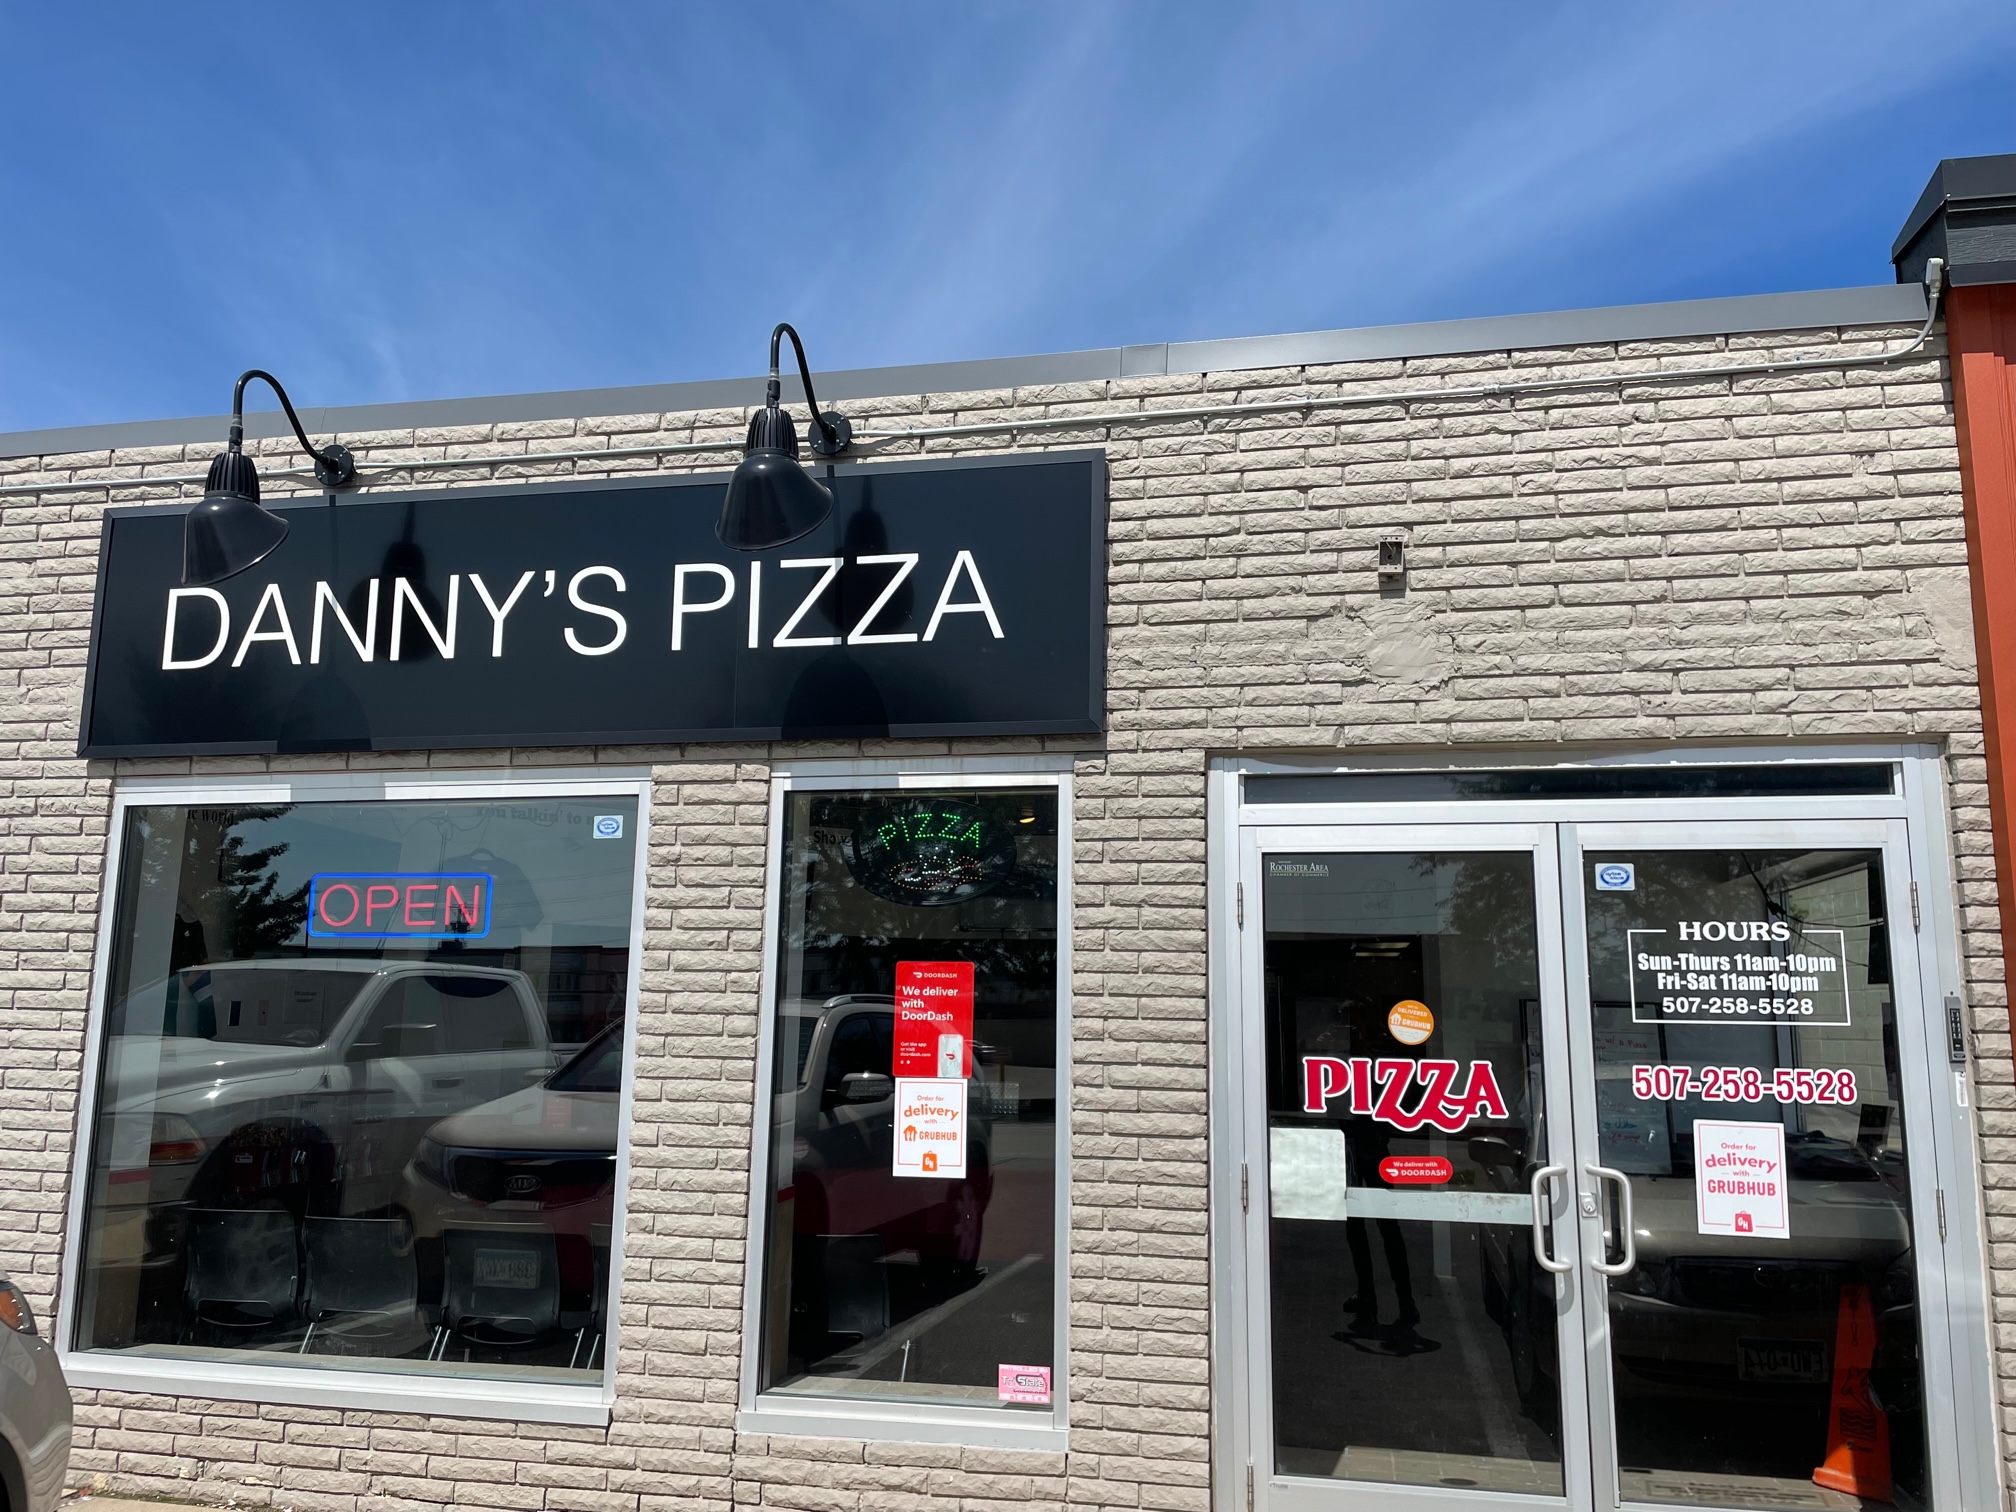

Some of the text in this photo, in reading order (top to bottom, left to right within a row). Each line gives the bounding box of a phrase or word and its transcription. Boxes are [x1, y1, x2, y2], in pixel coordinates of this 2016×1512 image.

[162, 549, 1005, 671] DANNY'S PIZZA
[878, 813, 981, 851] PIZZA
[319, 883, 480, 927] OPEN
[1678, 921, 1791, 942] HOURS
[1637, 952, 1837, 973] Sun-Thurs 11am-10pm
[902, 985, 959, 997] We deliver
[1657, 972, 1819, 992] Fri-Sat 11am-10pm
[901, 998, 925, 1009] with
[1398, 1007, 1428, 1017] DELIVERED
[1662, 997, 1814, 1015] 507-258-5528
[901, 1010, 954, 1021] DoorDash
[1402, 1018, 1430, 1029] GRUBHUB
[1632, 1065, 1857, 1103] 507-258-5528
[916, 1094, 934, 1102] Order
[1303, 1056, 1509, 1133] PIZZA
[903, 1103, 960, 1121] delivery
[919, 1131, 958, 1141] GRUBHUB
[1720, 1142, 1757, 1151] Order for
[1705, 1152, 1778, 1174] delivery
[1401, 1169, 1447, 1177] DOORDASH
[1707, 1179, 1777, 1197] GRUBHUB
